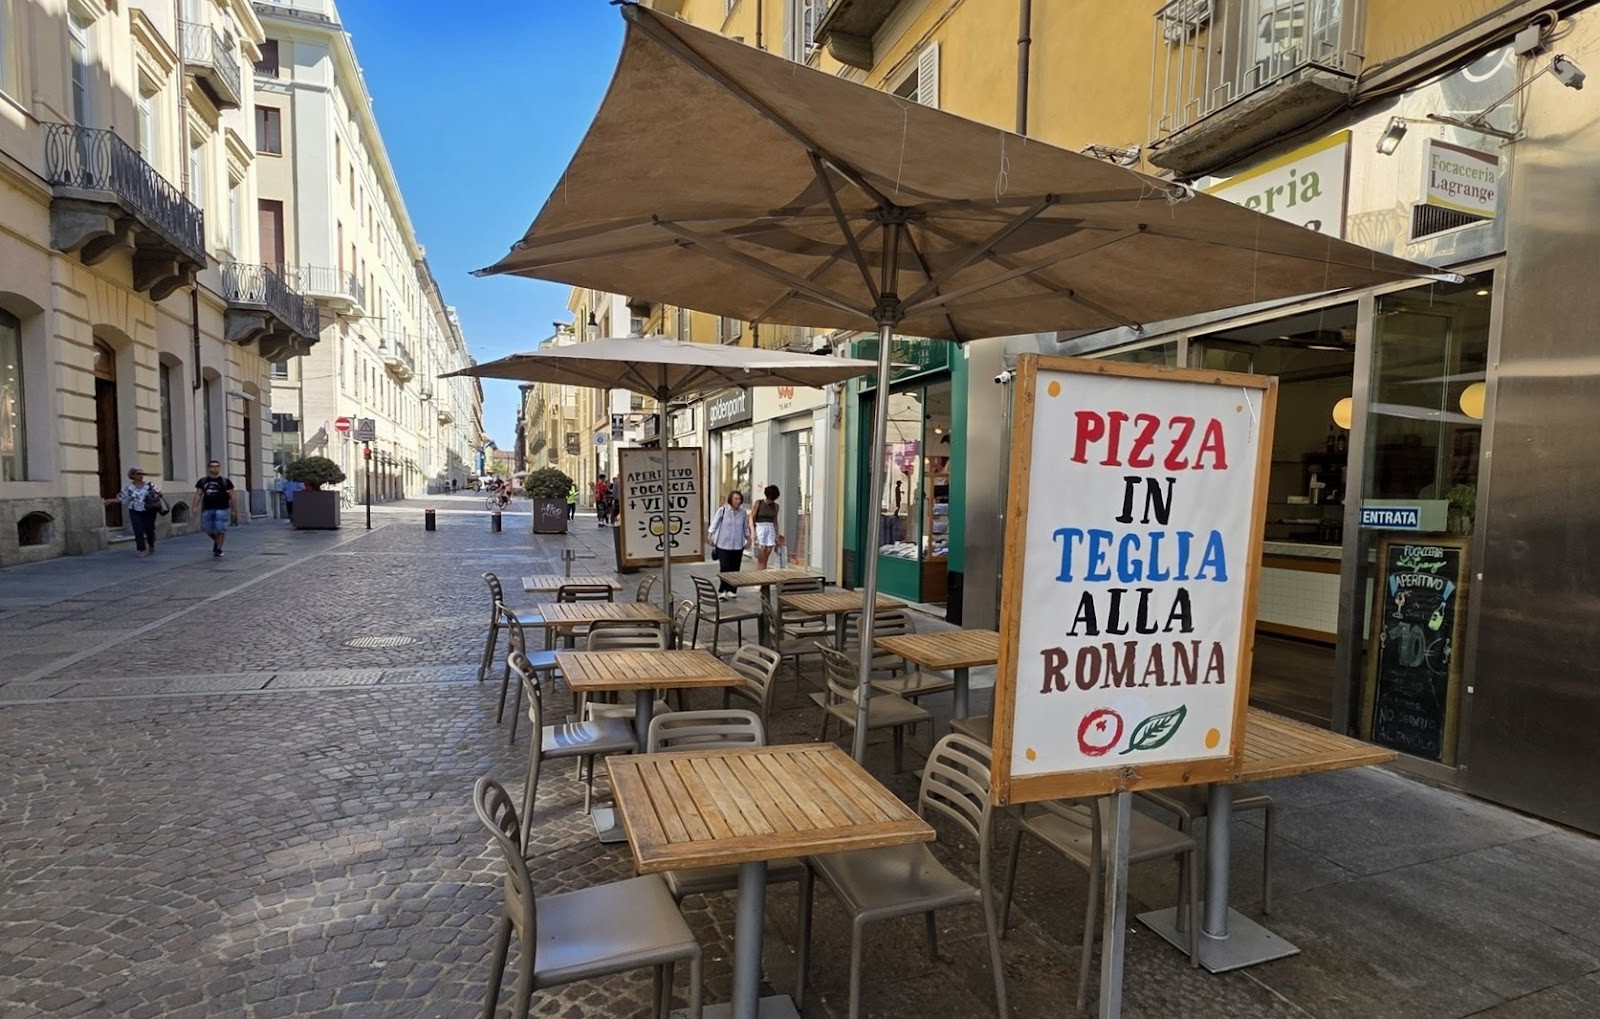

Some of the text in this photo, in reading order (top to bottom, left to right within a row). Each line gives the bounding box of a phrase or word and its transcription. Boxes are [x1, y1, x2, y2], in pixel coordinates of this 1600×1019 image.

[1432, 154, 1495, 183] Focacceria
[1431, 170, 1495, 204] Lagrange
[710, 391, 745, 426] goldenpoint
[1070, 411, 1228, 471] PIZZA
[627, 468, 692, 482] APERIIVO
[1115, 476, 1176, 525] IN
[1363, 511, 1416, 524] ENTRATA
[1053, 528, 1228, 583] TEGLIA
[1396, 574, 1443, 590] APERITIVO
[1066, 587, 1194, 636] ALLA
[1040, 640, 1225, 694] ROMANA
